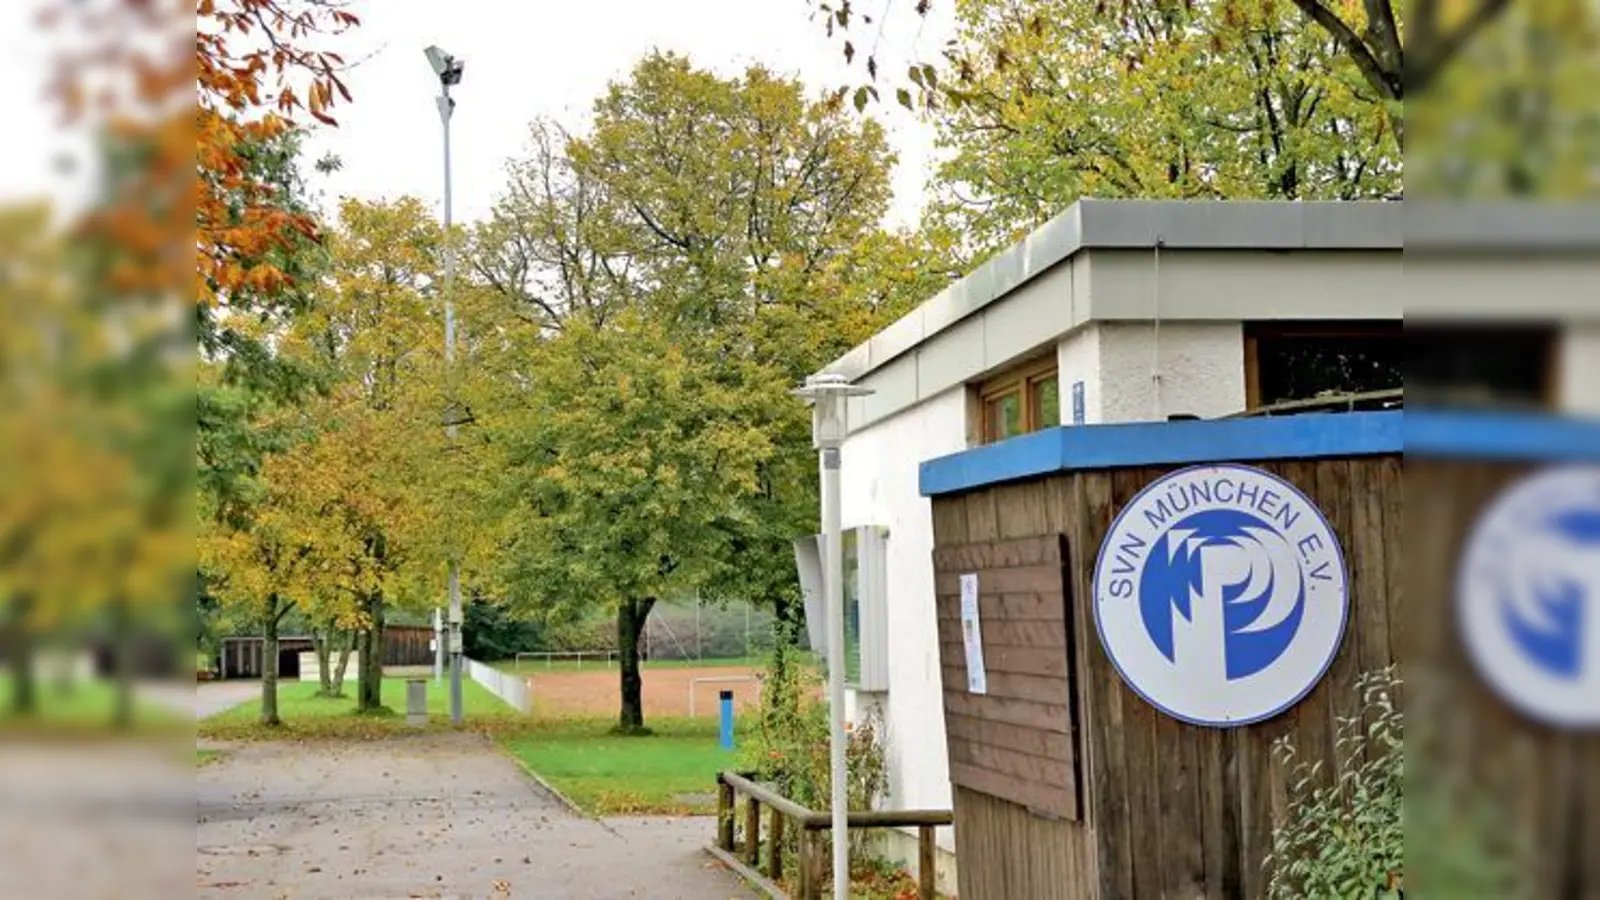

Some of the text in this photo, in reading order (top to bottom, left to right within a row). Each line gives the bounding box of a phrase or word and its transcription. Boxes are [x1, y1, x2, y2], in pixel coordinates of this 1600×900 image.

[1109, 478, 1333, 599] SVN MÜNCHEN E.V.
